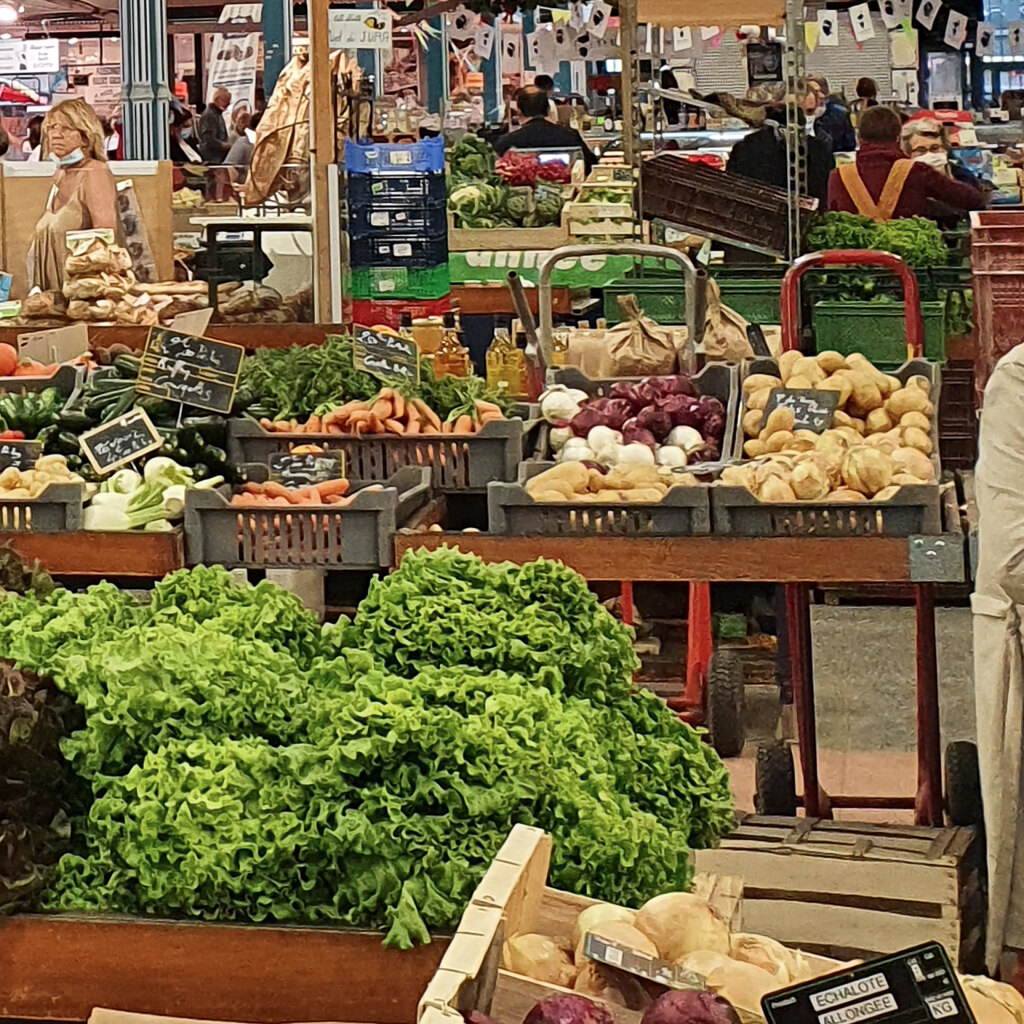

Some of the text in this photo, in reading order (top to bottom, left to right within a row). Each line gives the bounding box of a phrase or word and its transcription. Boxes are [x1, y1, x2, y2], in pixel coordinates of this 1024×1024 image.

[815, 974, 887, 1008] ECHALOTE
[823, 996, 894, 1024] ALLONGEE
[932, 1001, 953, 1016] KG
